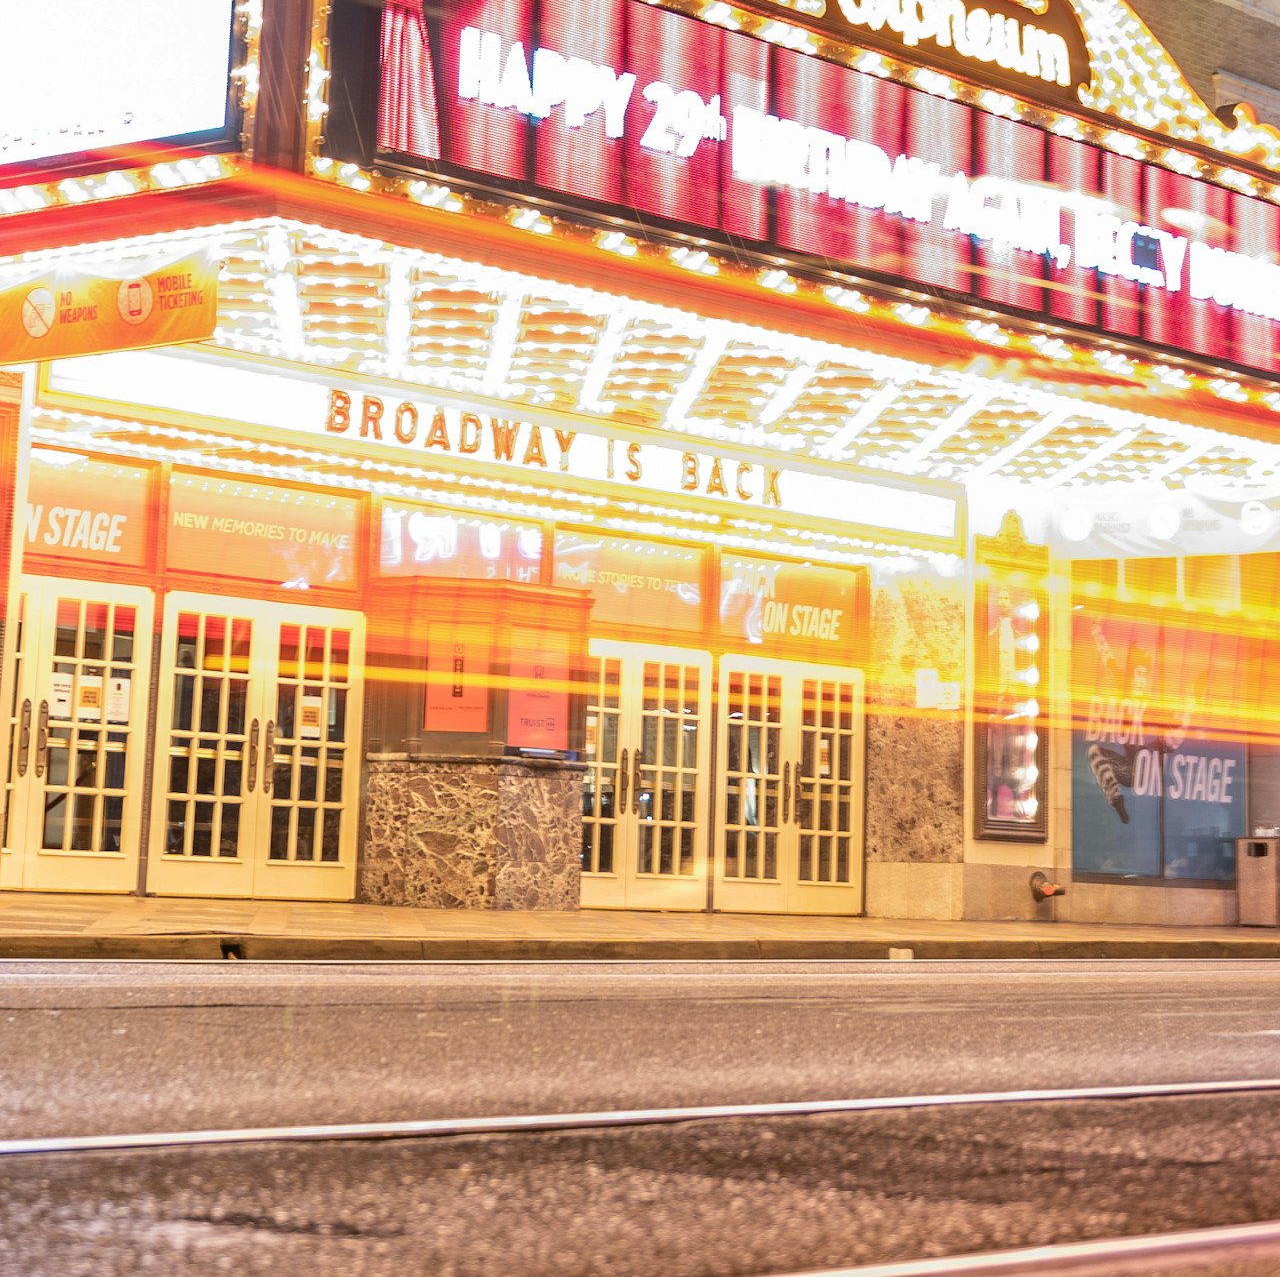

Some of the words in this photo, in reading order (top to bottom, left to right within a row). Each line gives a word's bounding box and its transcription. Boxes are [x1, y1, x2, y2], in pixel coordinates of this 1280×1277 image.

[458, 26, 636, 139] HAPPY
[60, 291, 72, 307] NO
[156, 273, 193, 293] MOBILE
[158, 290, 204, 312] TICKETING
[59, 306, 98, 325] WEAPONS
[326, 389, 577, 472] BROADWAY
[606, 438, 643, 482] IS
[681, 451, 782, 507] BACK
[43, 505, 128, 553] STAGE
[172, 511, 209, 530] NEW
[211, 517, 286, 541] MEMORIES
[288, 527, 308, 544] TO
[308, 529, 351, 550] MAKE
[597, 570, 645, 589] STORIES
[647, 576, 662, 591] TO
[762, 600, 789, 634] ON
[789, 604, 843, 641] STAGE
[1085, 695, 1148, 746] BACK
[1133, 748, 1167, 798] ON
[1168, 753, 1236, 804] STAGE
